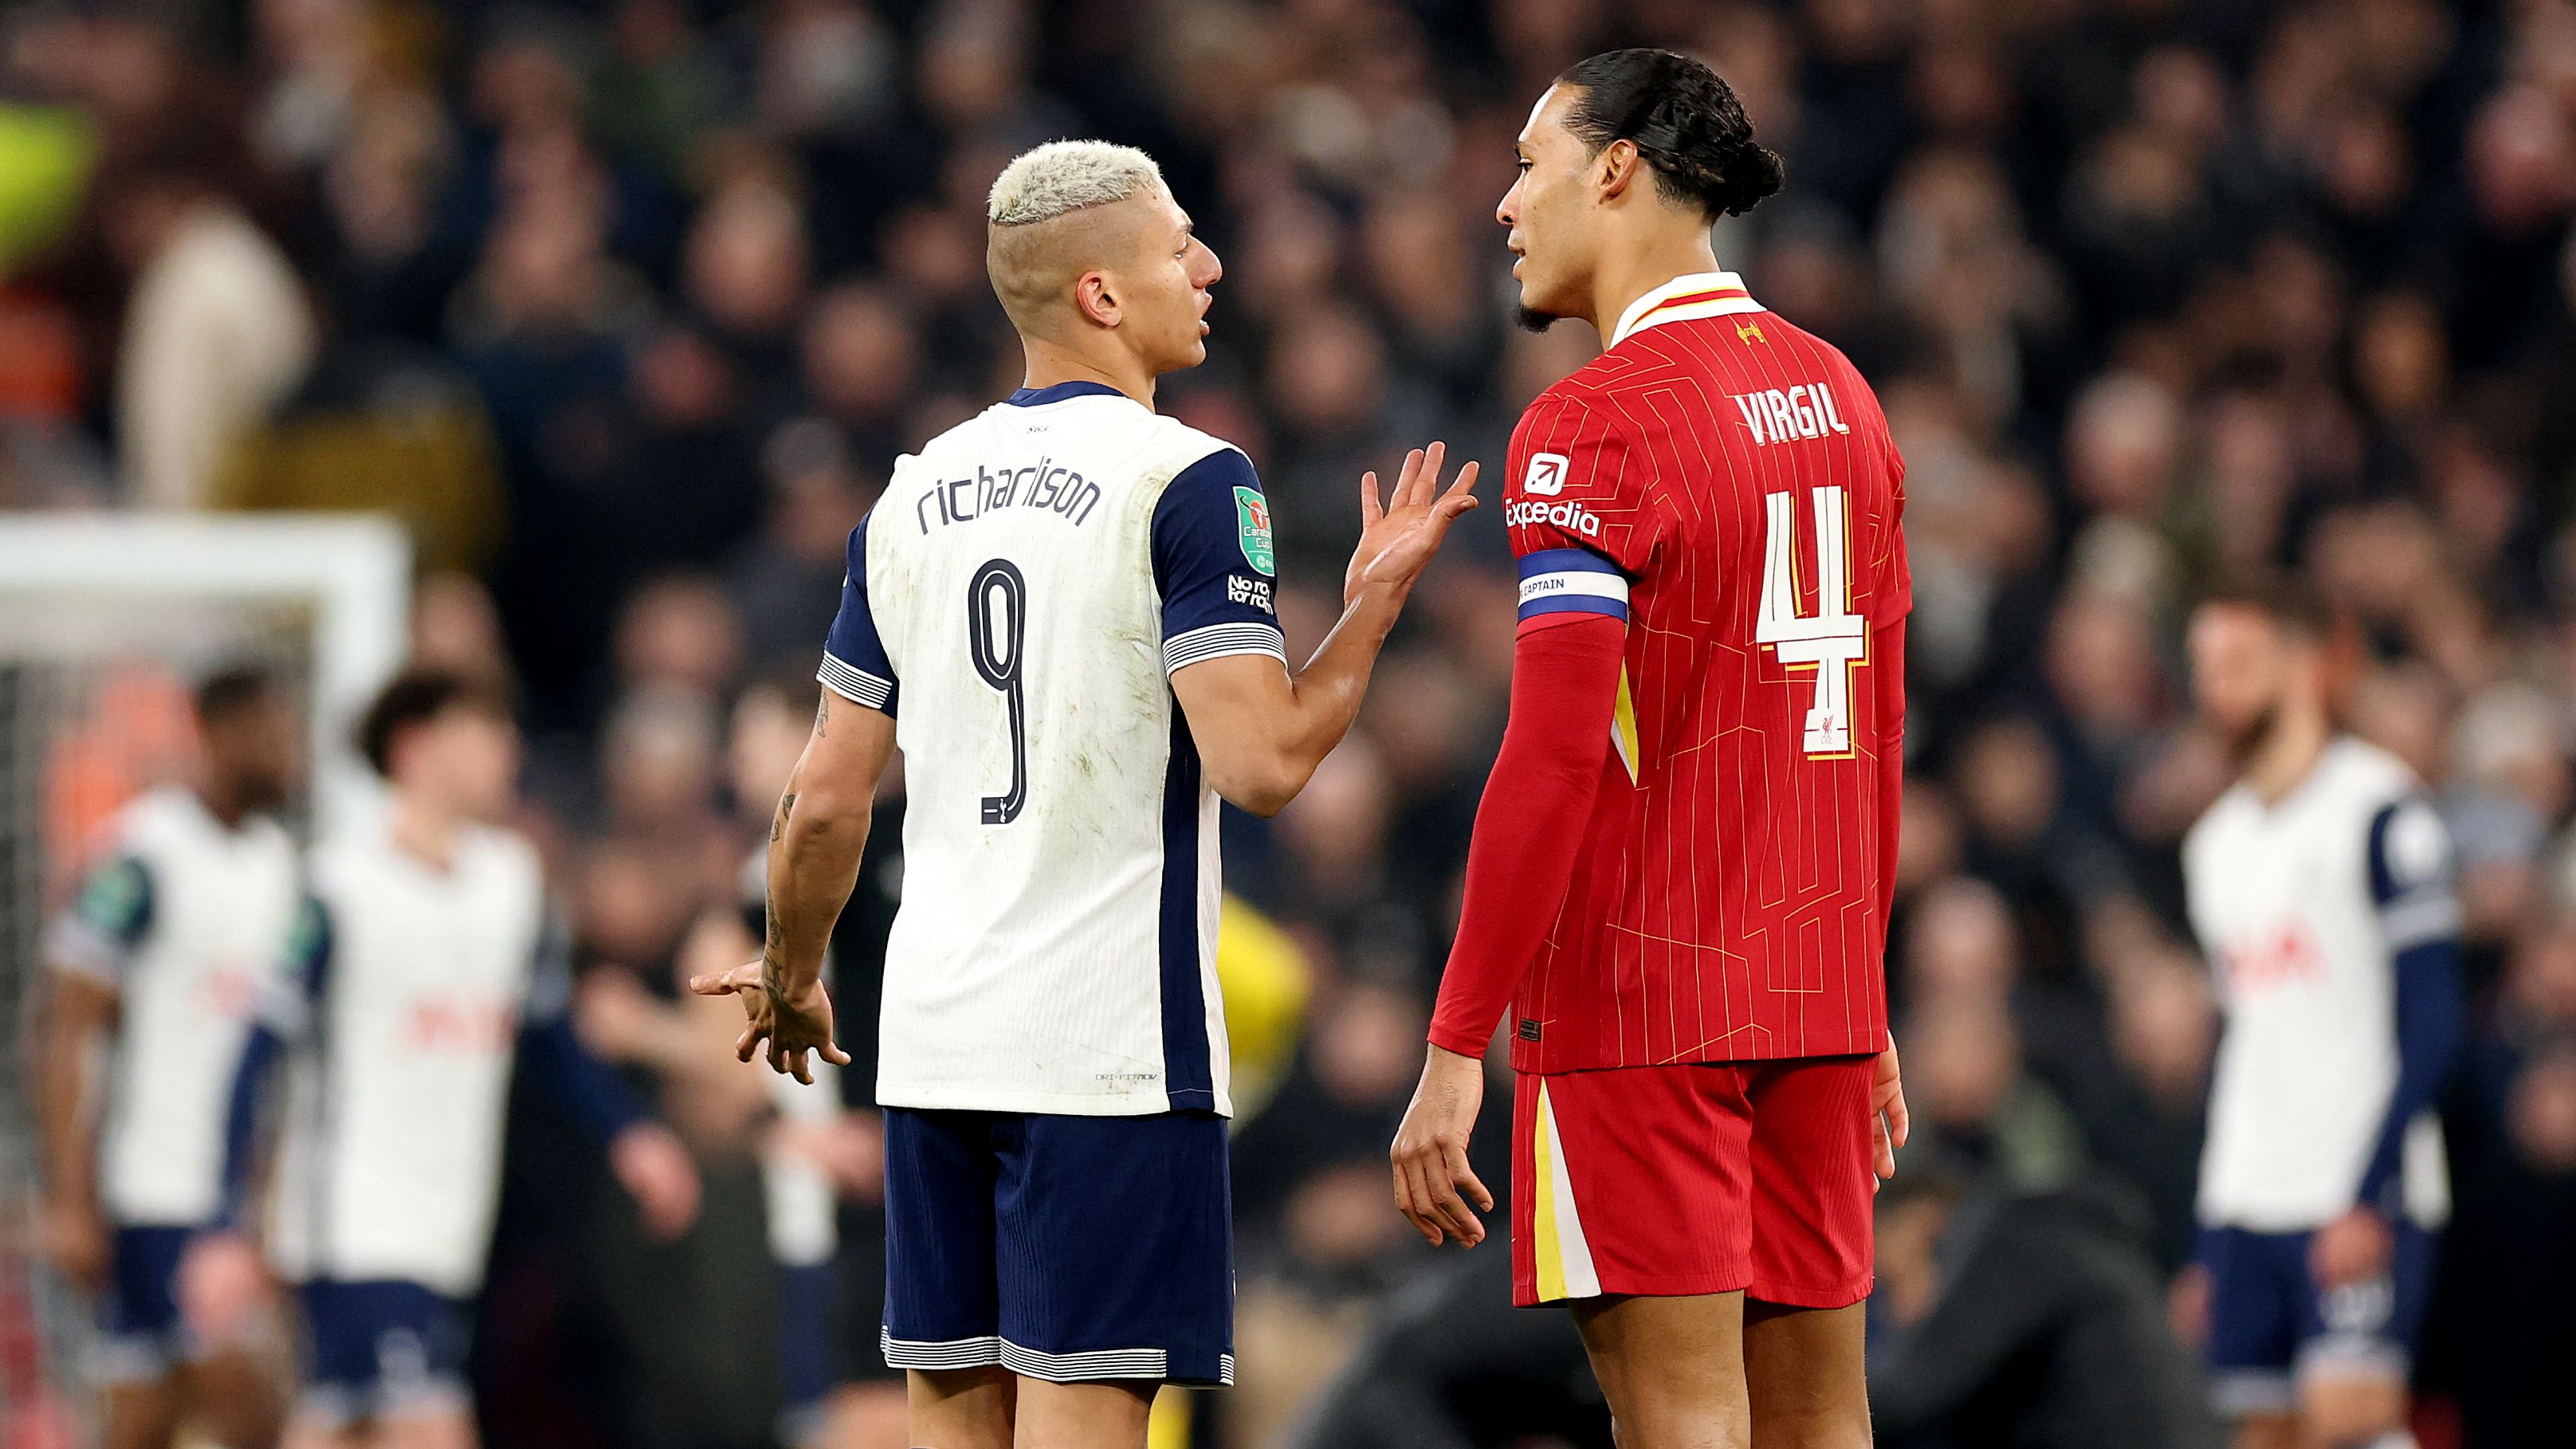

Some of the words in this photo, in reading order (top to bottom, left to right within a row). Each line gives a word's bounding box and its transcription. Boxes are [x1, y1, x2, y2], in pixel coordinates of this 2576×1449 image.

[1735, 382, 1849, 446] VIRGIL
[917, 455, 1101, 536] richarlison
[1505, 497, 1600, 537] Expedia
[1227, 575, 1253, 591] No
[1228, 587, 1251, 604] For
[1524, 579, 1565, 596] CAPTAIN
[1756, 485, 1870, 760] 4
[968, 559, 1026, 825] 9
